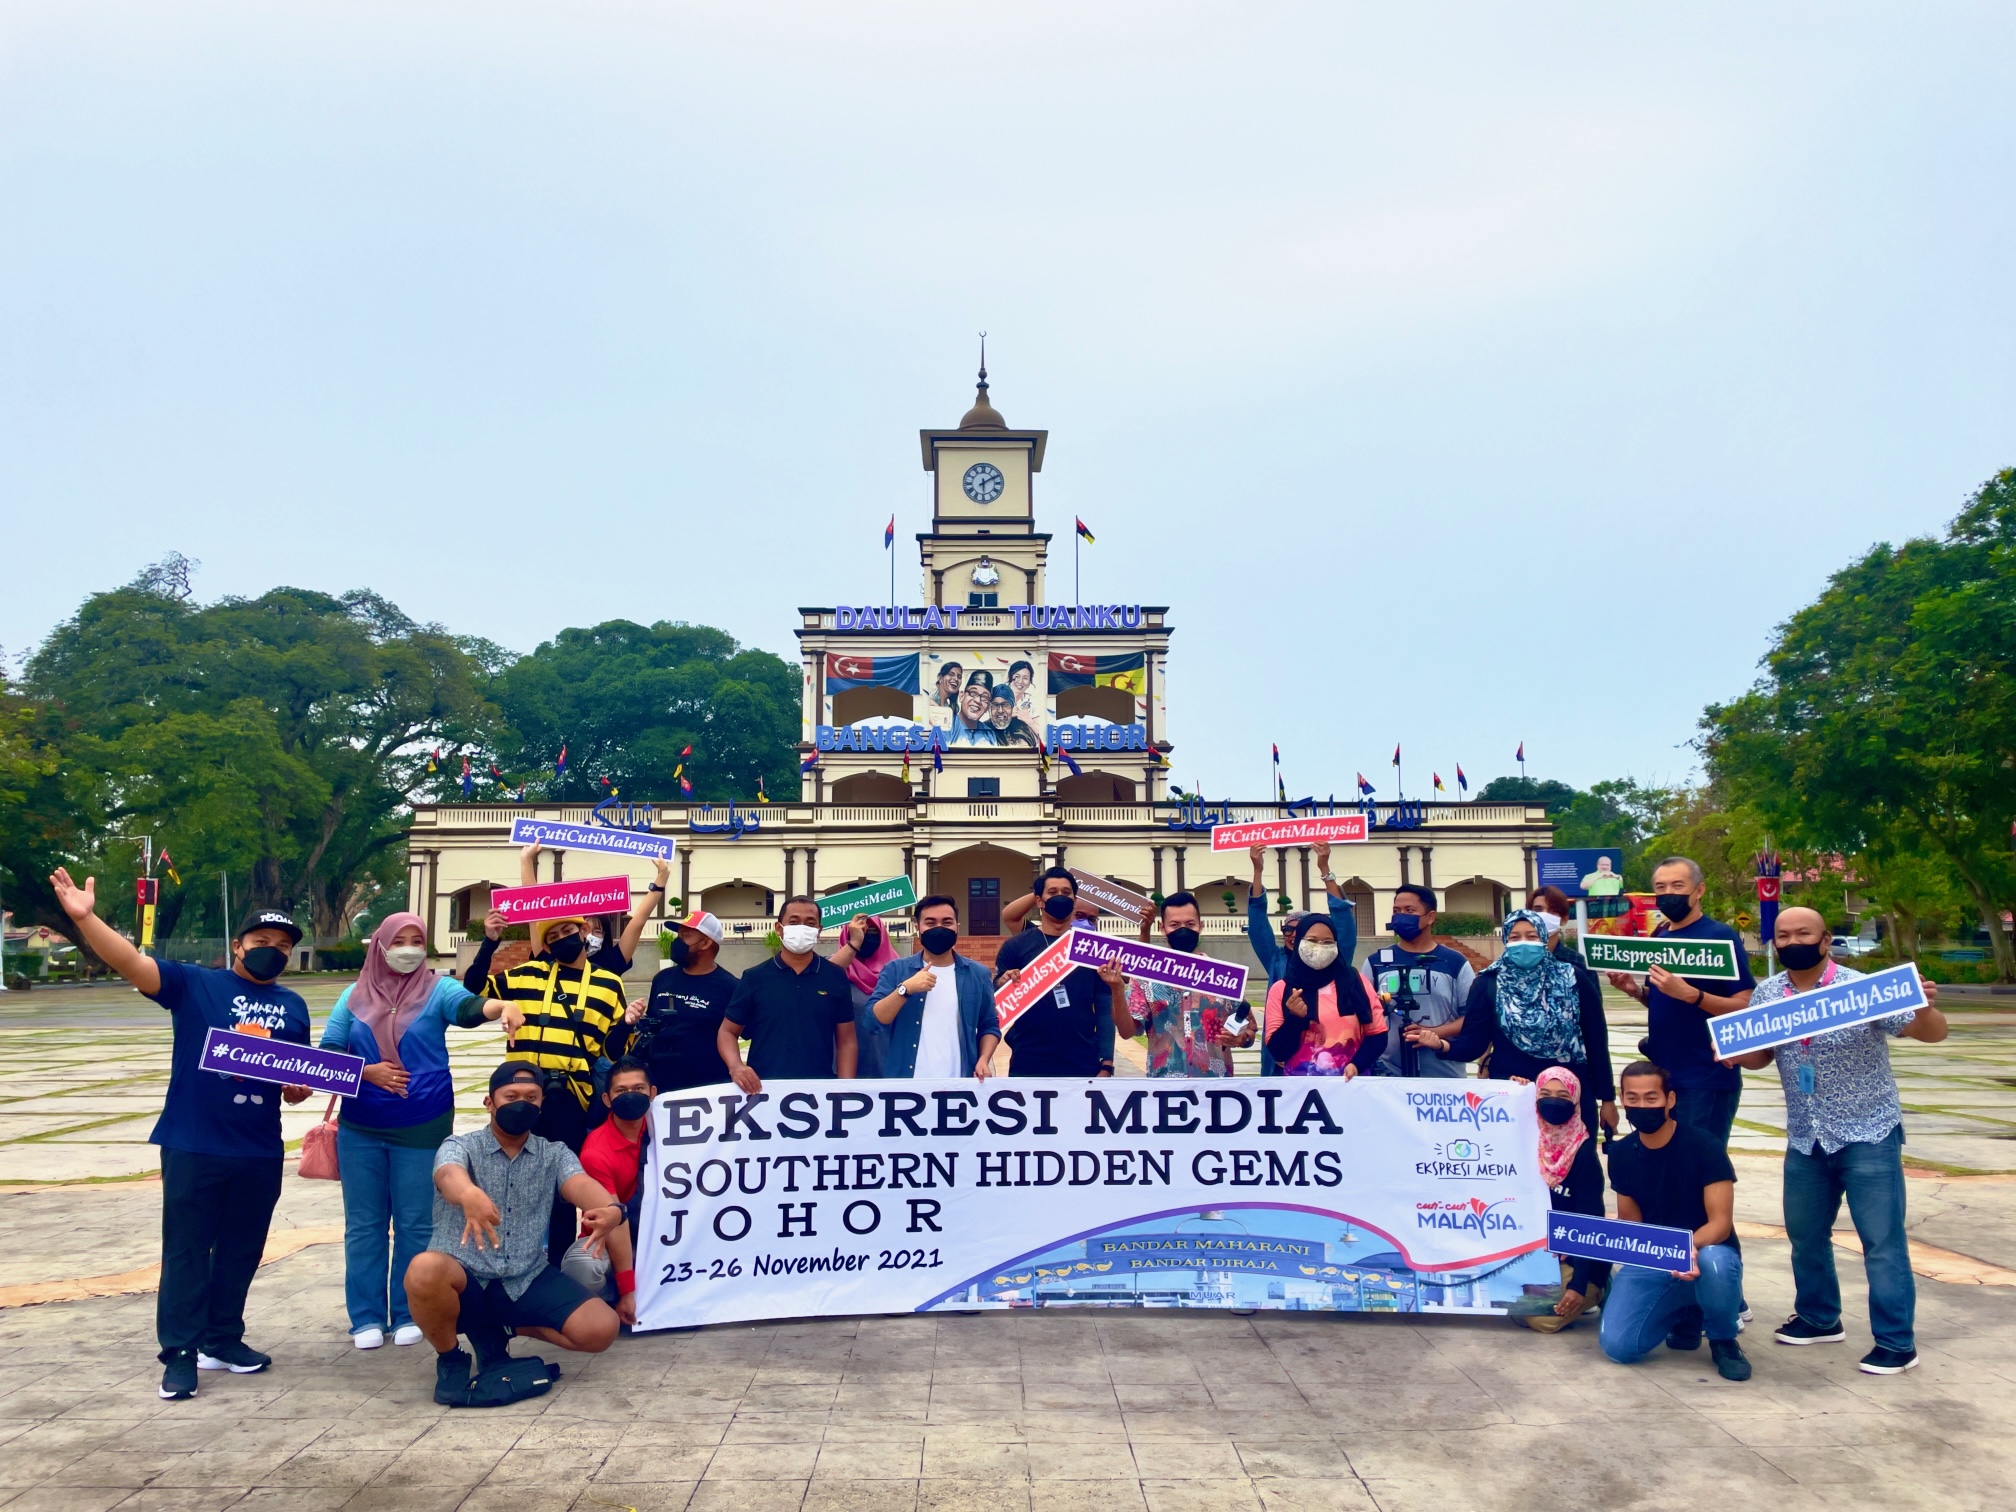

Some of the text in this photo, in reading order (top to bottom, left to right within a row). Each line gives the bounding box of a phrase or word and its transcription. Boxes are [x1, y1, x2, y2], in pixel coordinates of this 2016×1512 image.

[836, 604, 1142, 630] DAULAT TUANKU
[815, 723, 1148, 754] BANGSA JOHOR
[518, 824, 668, 855] #CutiCutiMalaysia
[1218, 821, 1361, 845] #CutiCutiMalaysia
[498, 889, 625, 914] #CutiCutiMalaysia
[821, 887, 903, 918] EkspresiMedia
[1075, 878, 1142, 915] CutiCutiMalaysi
[1074, 936, 1239, 990] #MalaysiaTrulyAsia
[1591, 943, 1725, 968] #EkspresiMedia
[1719, 979, 1913, 1046] #MalaysiaTrulyAsia
[211, 1042, 357, 1083] #CutiCutiMalaysia
[1406, 1092, 1466, 1106] TOURISM
[662, 1088, 1344, 1146] EKSPRESI MEDIA
[1416, 1106, 1510, 1131] MALAYSIA
[661, 1149, 1343, 1200] SOUTHERN HIDDEN GEMS
[1416, 1161, 1518, 1177] EKSPRESI MEDIA
[1417, 1212, 1518, 1239] MALAYSIA
[1103, 1240, 1311, 1256] BANDAR MAHARANI
[1553, 1225, 1687, 1261] #CutiCutiMalaysia
[660, 1246, 944, 1286] 23-26 November 2021
[1130, 1258, 1280, 1270] BANDAR DIRAJA
[1189, 1290, 1237, 1300] MUAR
